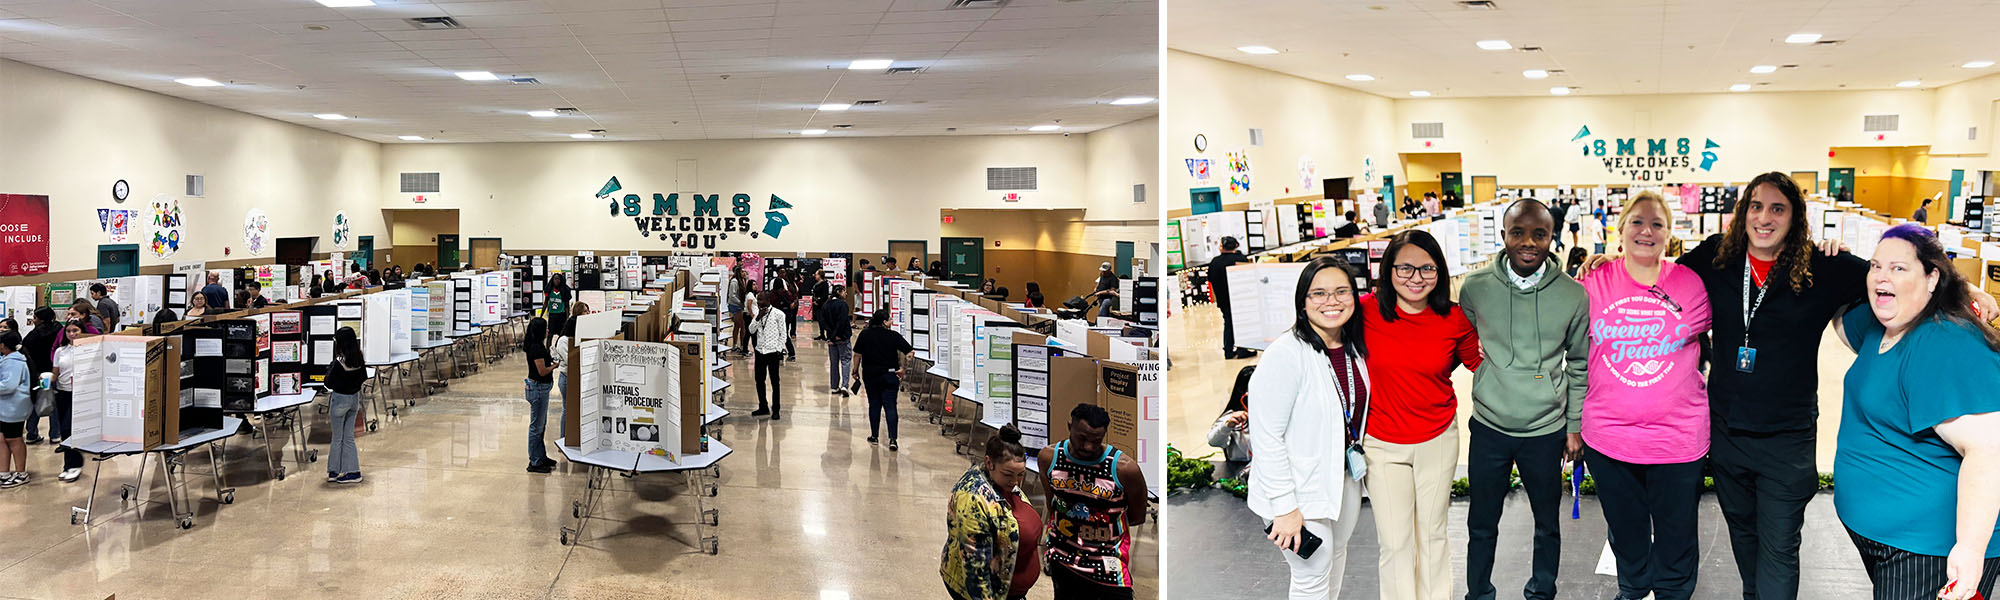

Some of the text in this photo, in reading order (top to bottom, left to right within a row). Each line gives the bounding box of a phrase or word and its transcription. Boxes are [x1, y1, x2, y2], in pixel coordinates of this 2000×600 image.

[1602, 156, 1690, 168] WELCOMES
[1630, 170, 1664, 181] YOU
[623, 193, 751, 216] SMMS
[634, 217, 751, 232] WELCOMES
[4, 234, 44, 244] INCLUDE.
[670, 233, 717, 249] YOU
[1592, 315, 1666, 346] Science
[1611, 324, 1692, 363] Teacher
[1110, 371, 1130, 380] Project
[1610, 366, 1620, 378] YOU
[1626, 379, 1637, 387] DO
[602, 384, 640, 397] MATERIALS
[624, 395, 663, 408] PROCEDURE
[1051, 478, 1113, 499] PAC-MAN
